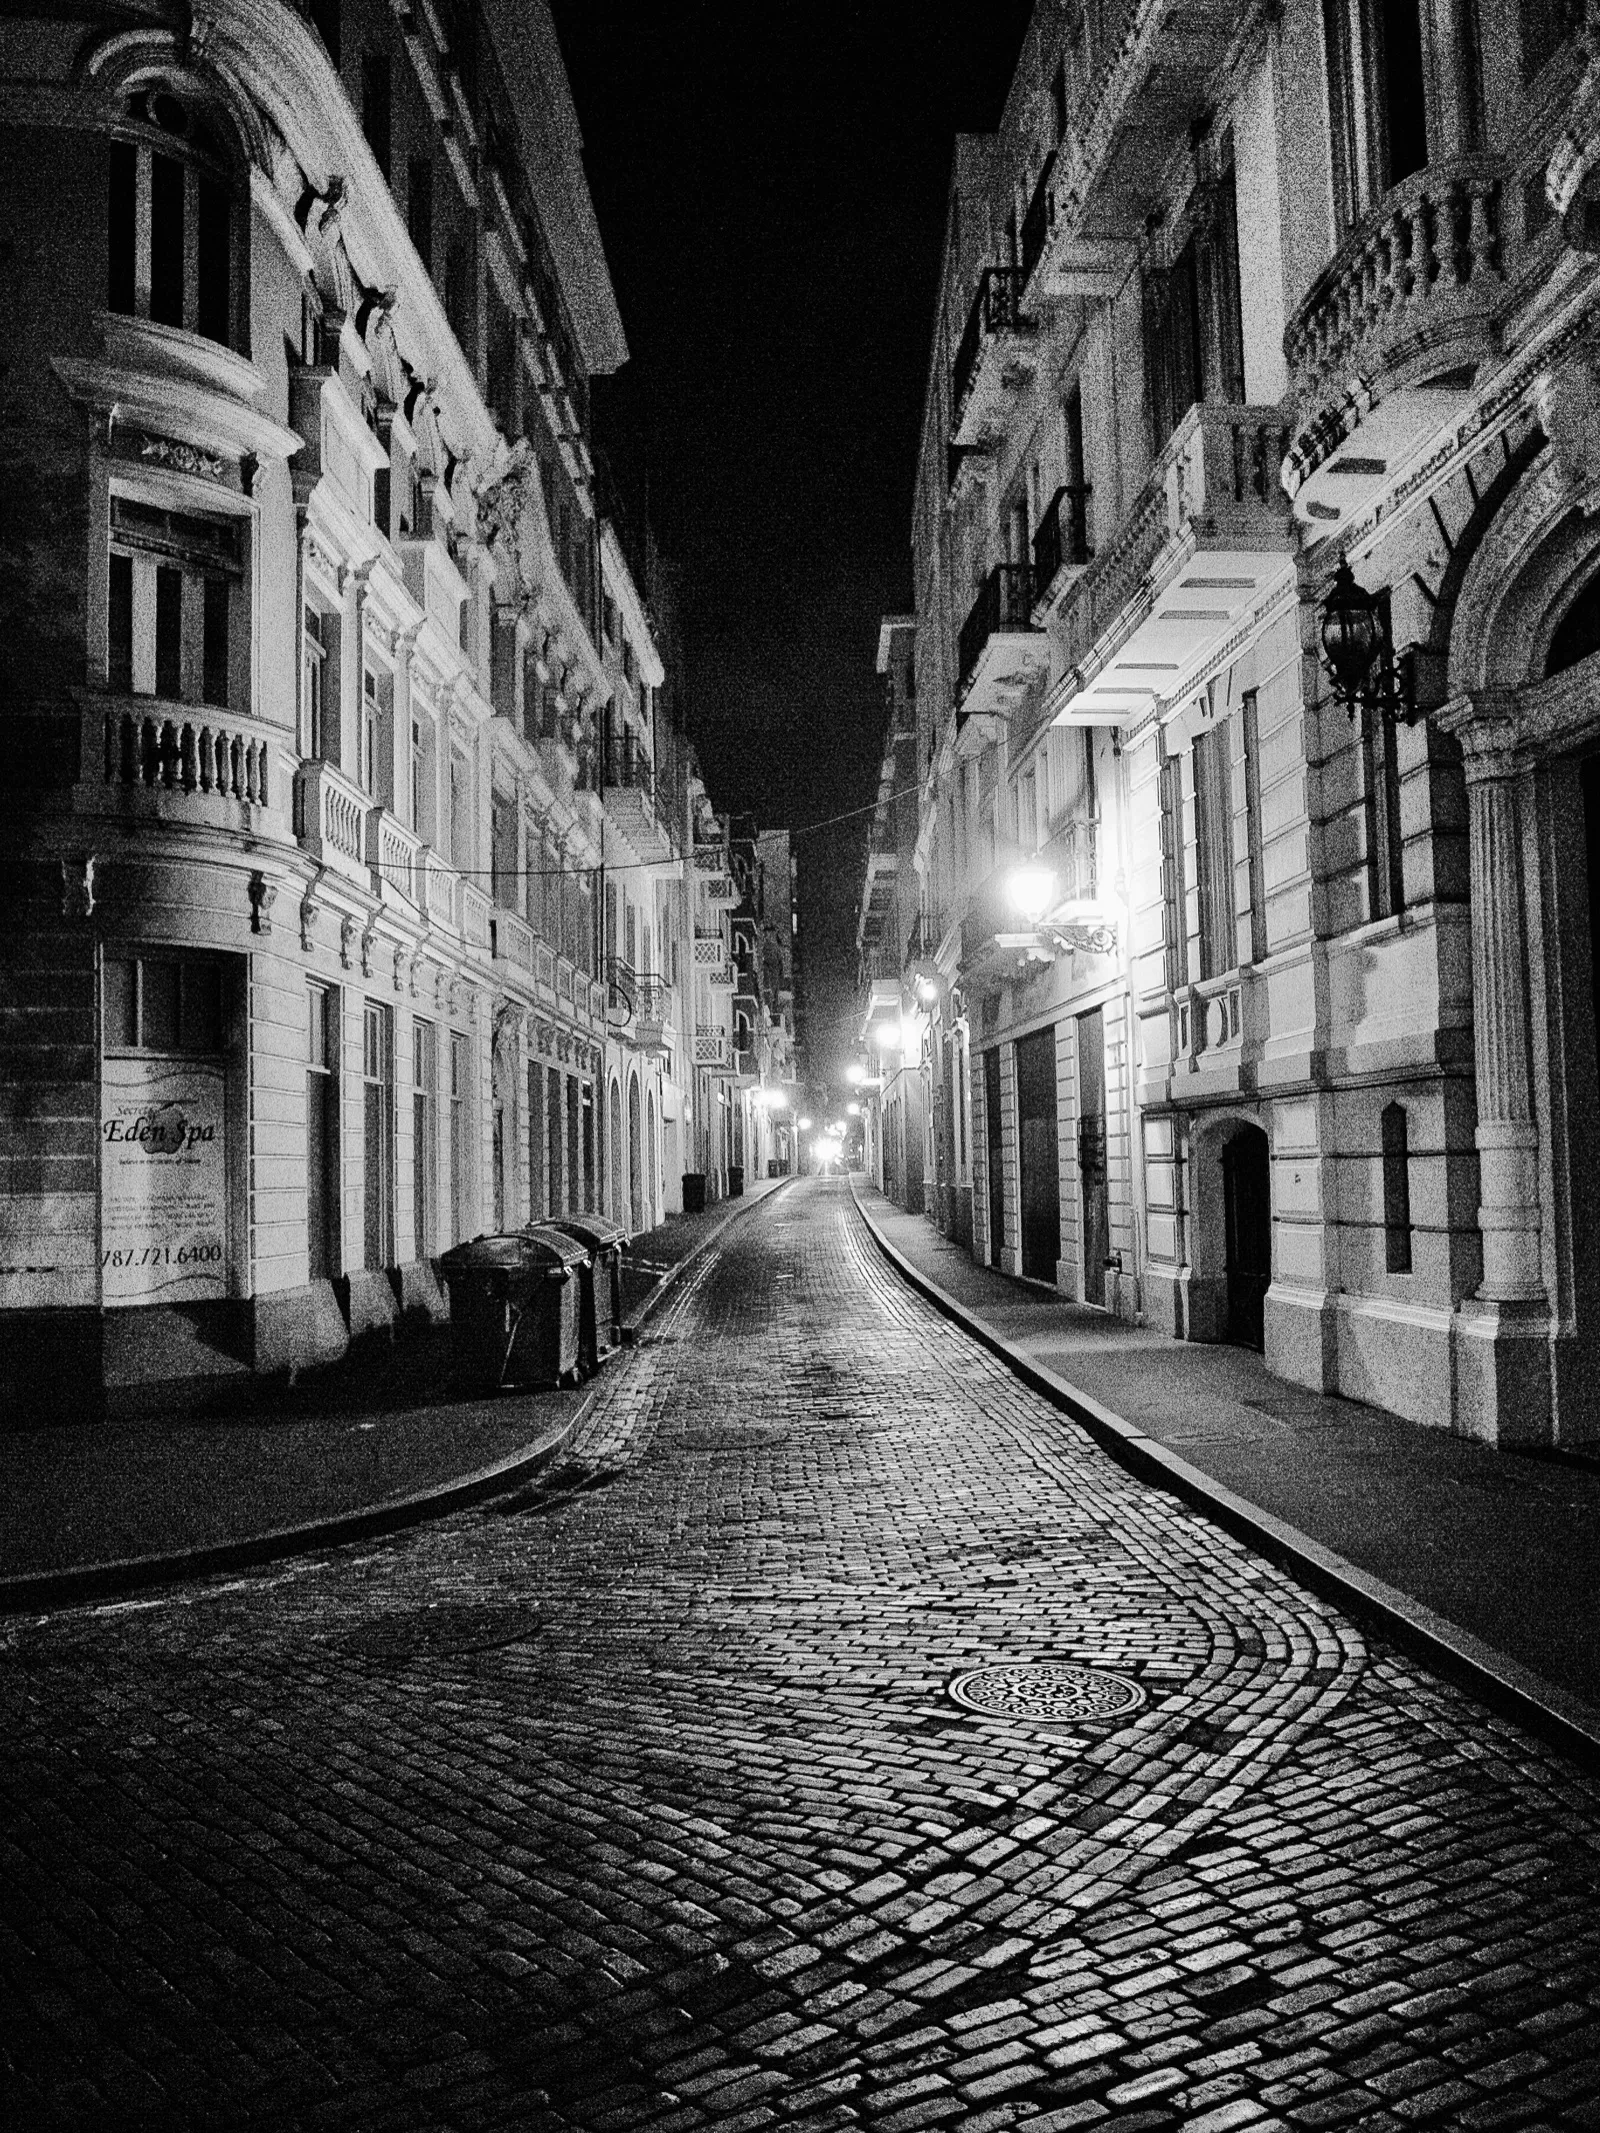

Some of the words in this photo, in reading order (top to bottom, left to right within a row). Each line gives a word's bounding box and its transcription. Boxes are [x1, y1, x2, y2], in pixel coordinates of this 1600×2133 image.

[103, 1117, 165, 1142] Eden
[172, 1119, 215, 1150] Spa
[101, 1244, 222, 1268] 787.721.6400
